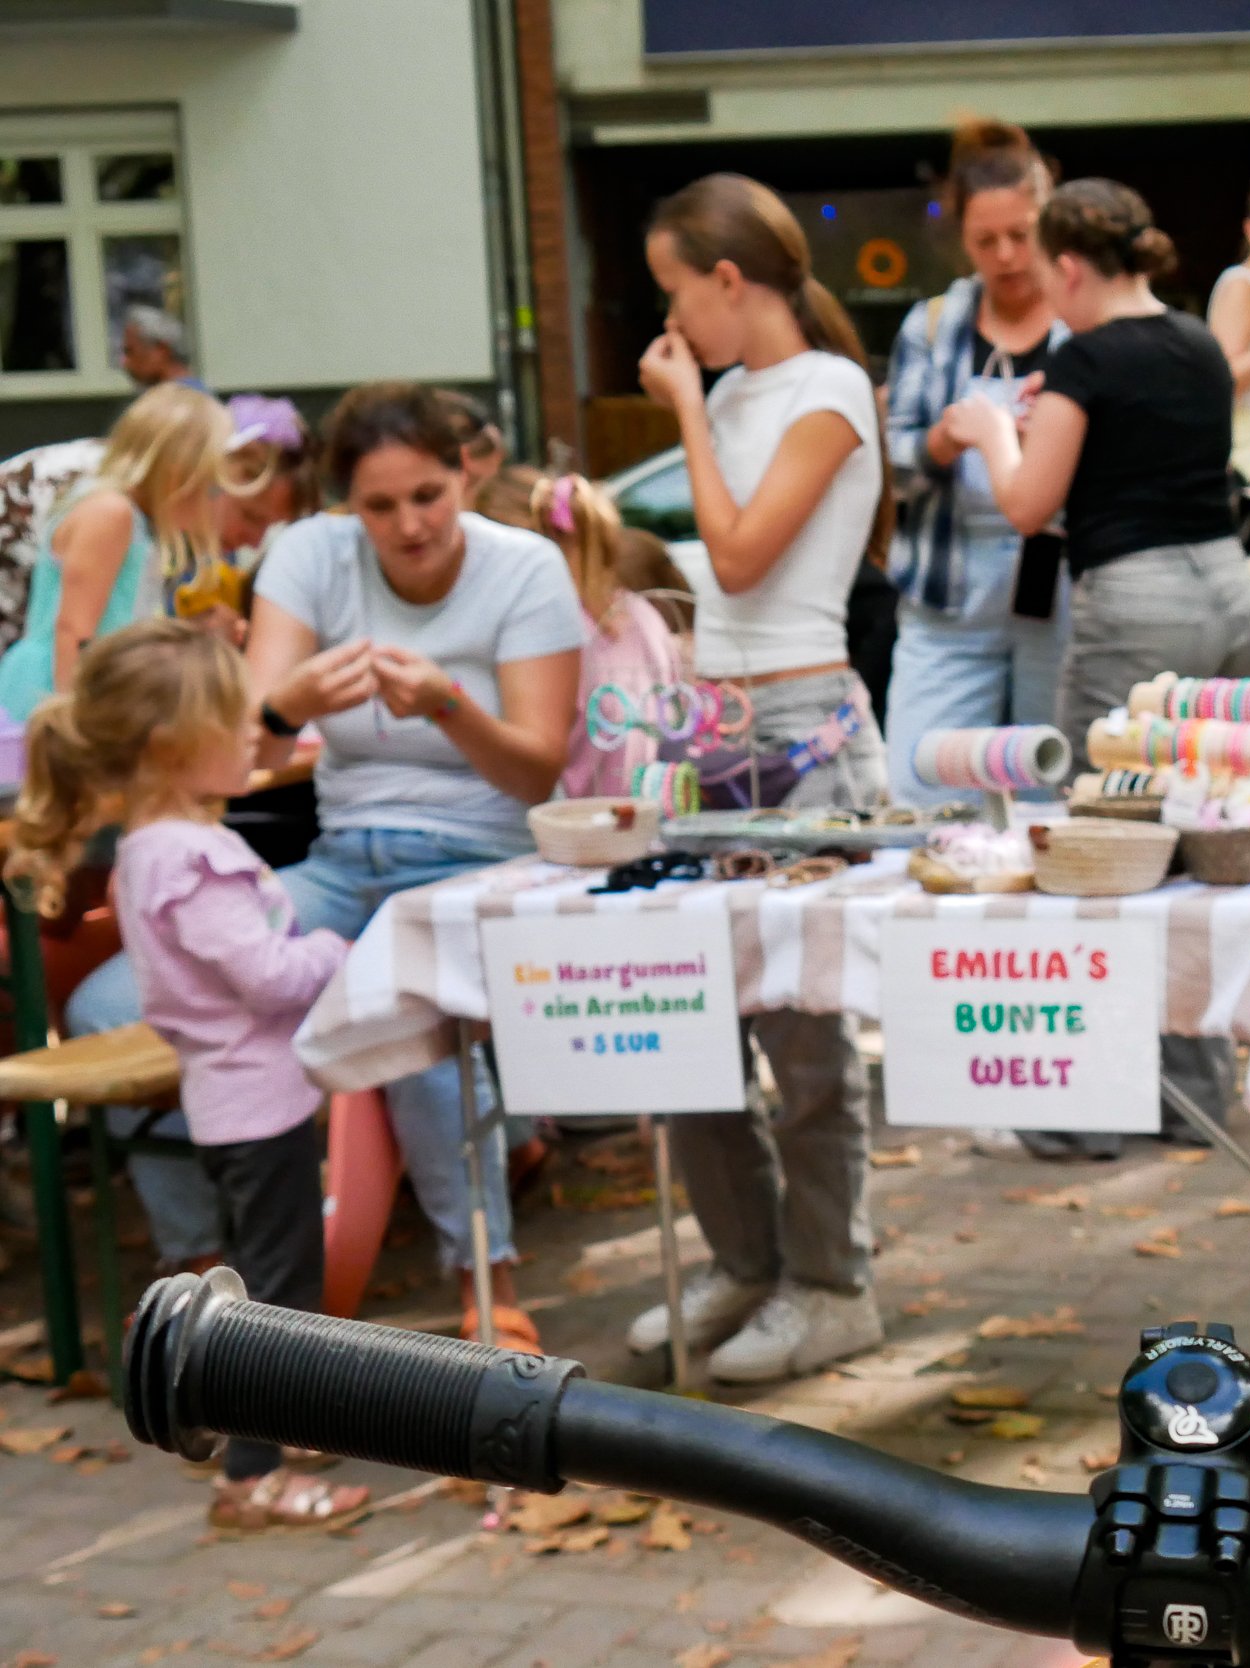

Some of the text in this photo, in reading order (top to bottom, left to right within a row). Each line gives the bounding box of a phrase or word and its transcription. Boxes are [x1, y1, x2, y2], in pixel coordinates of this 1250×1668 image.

[558, 952, 706, 989] Haargummi
[543, 996, 579, 1018] ein
[587, 990, 705, 1018] Armband
[955, 1003, 1086, 1034] BUNTE
[613, 1031, 661, 1052] EUR
[970, 1056, 1073, 1087] WELT
